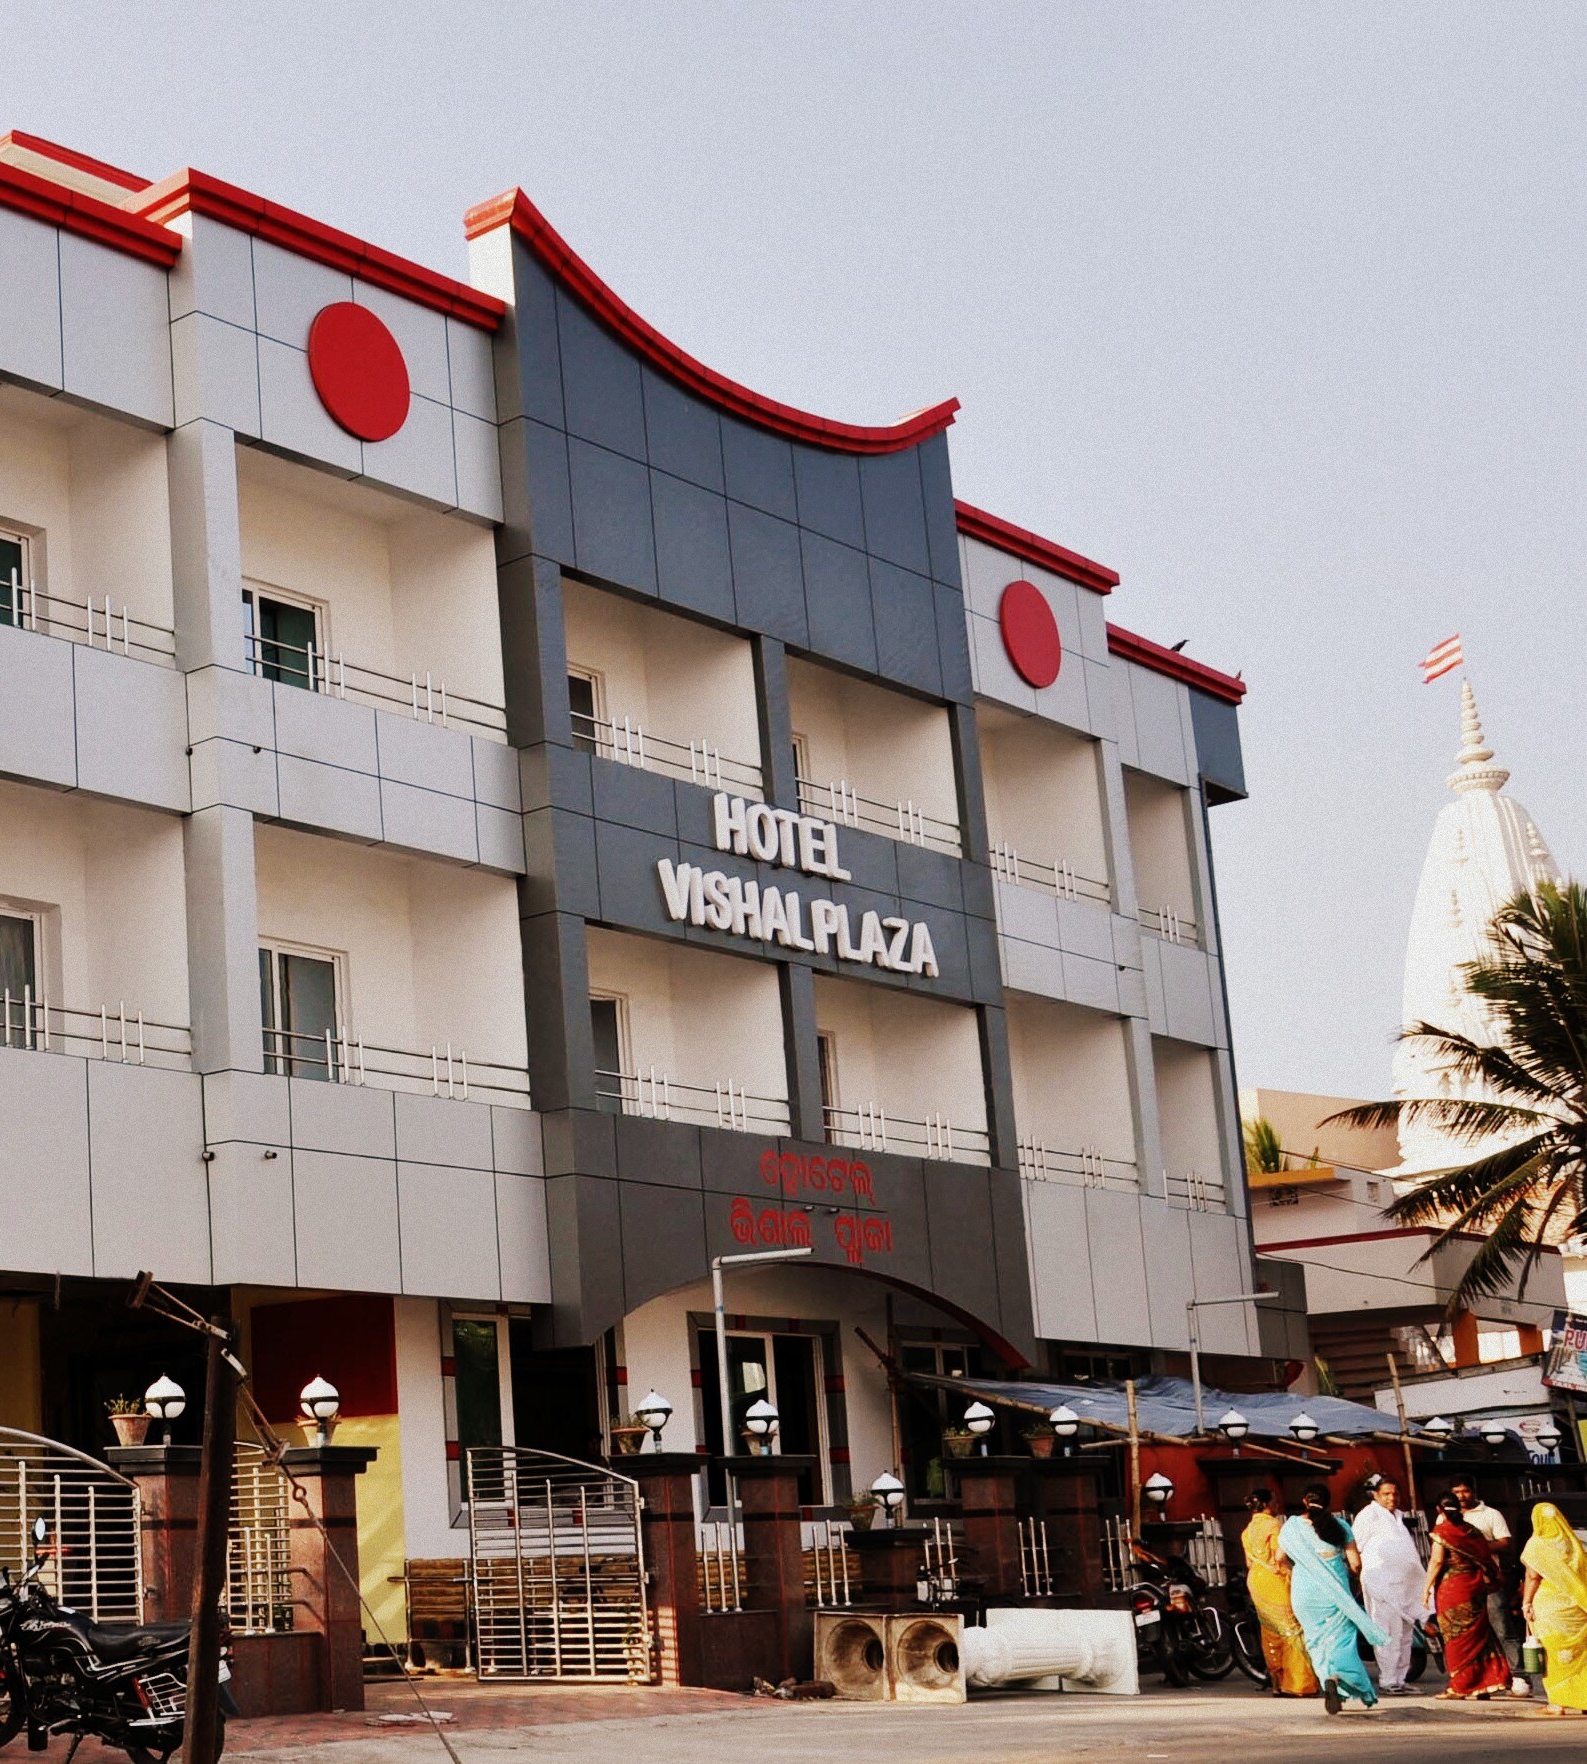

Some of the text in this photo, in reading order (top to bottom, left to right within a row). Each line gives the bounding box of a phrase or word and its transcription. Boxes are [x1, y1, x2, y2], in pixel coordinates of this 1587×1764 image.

[714, 793, 852, 881] HOTEL
[658, 858, 940, 978] VISHAL PLAZA
[1564, 1330, 1587, 1350] PU
